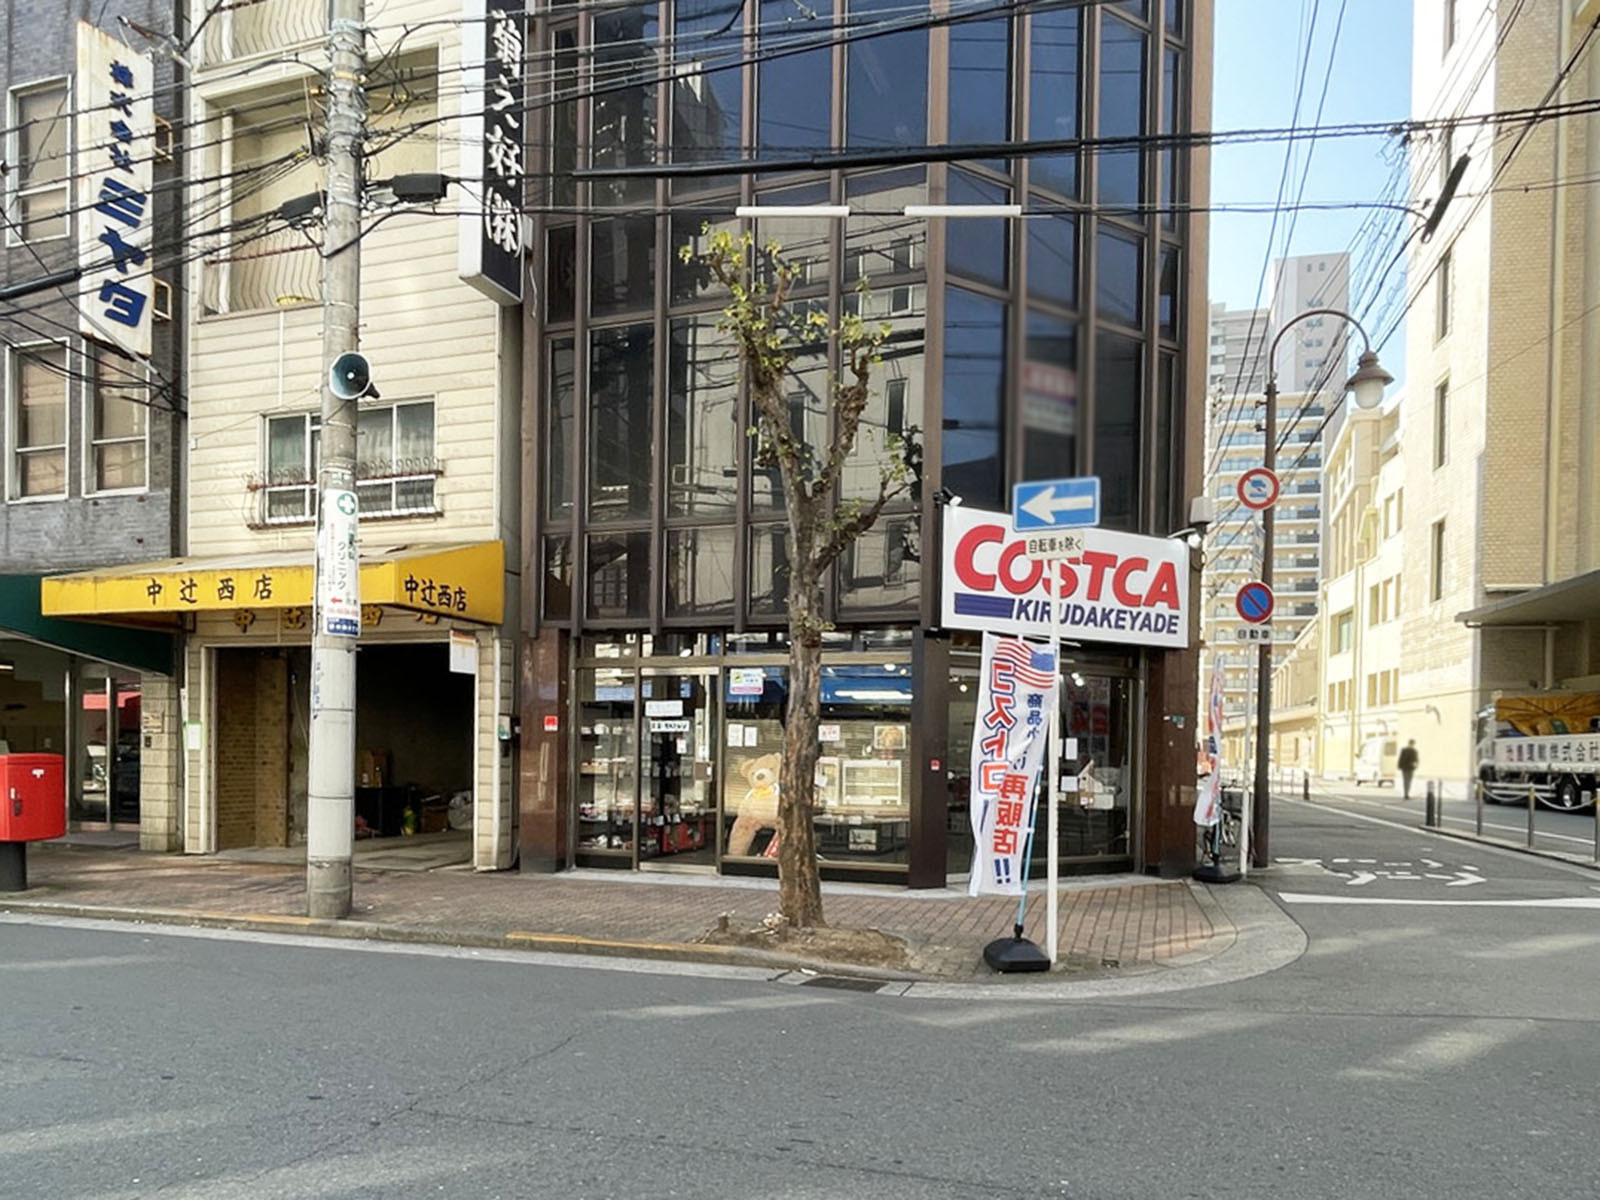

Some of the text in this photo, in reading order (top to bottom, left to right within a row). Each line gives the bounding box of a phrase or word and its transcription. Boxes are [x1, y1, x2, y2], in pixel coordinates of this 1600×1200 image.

[954, 524, 1181, 611] COSTCA
[146, 573, 273, 606] 中辻西店
[404, 573, 467, 612] 中辻西店
[1015, 598, 1180, 635] KIRUDAKEYADE
